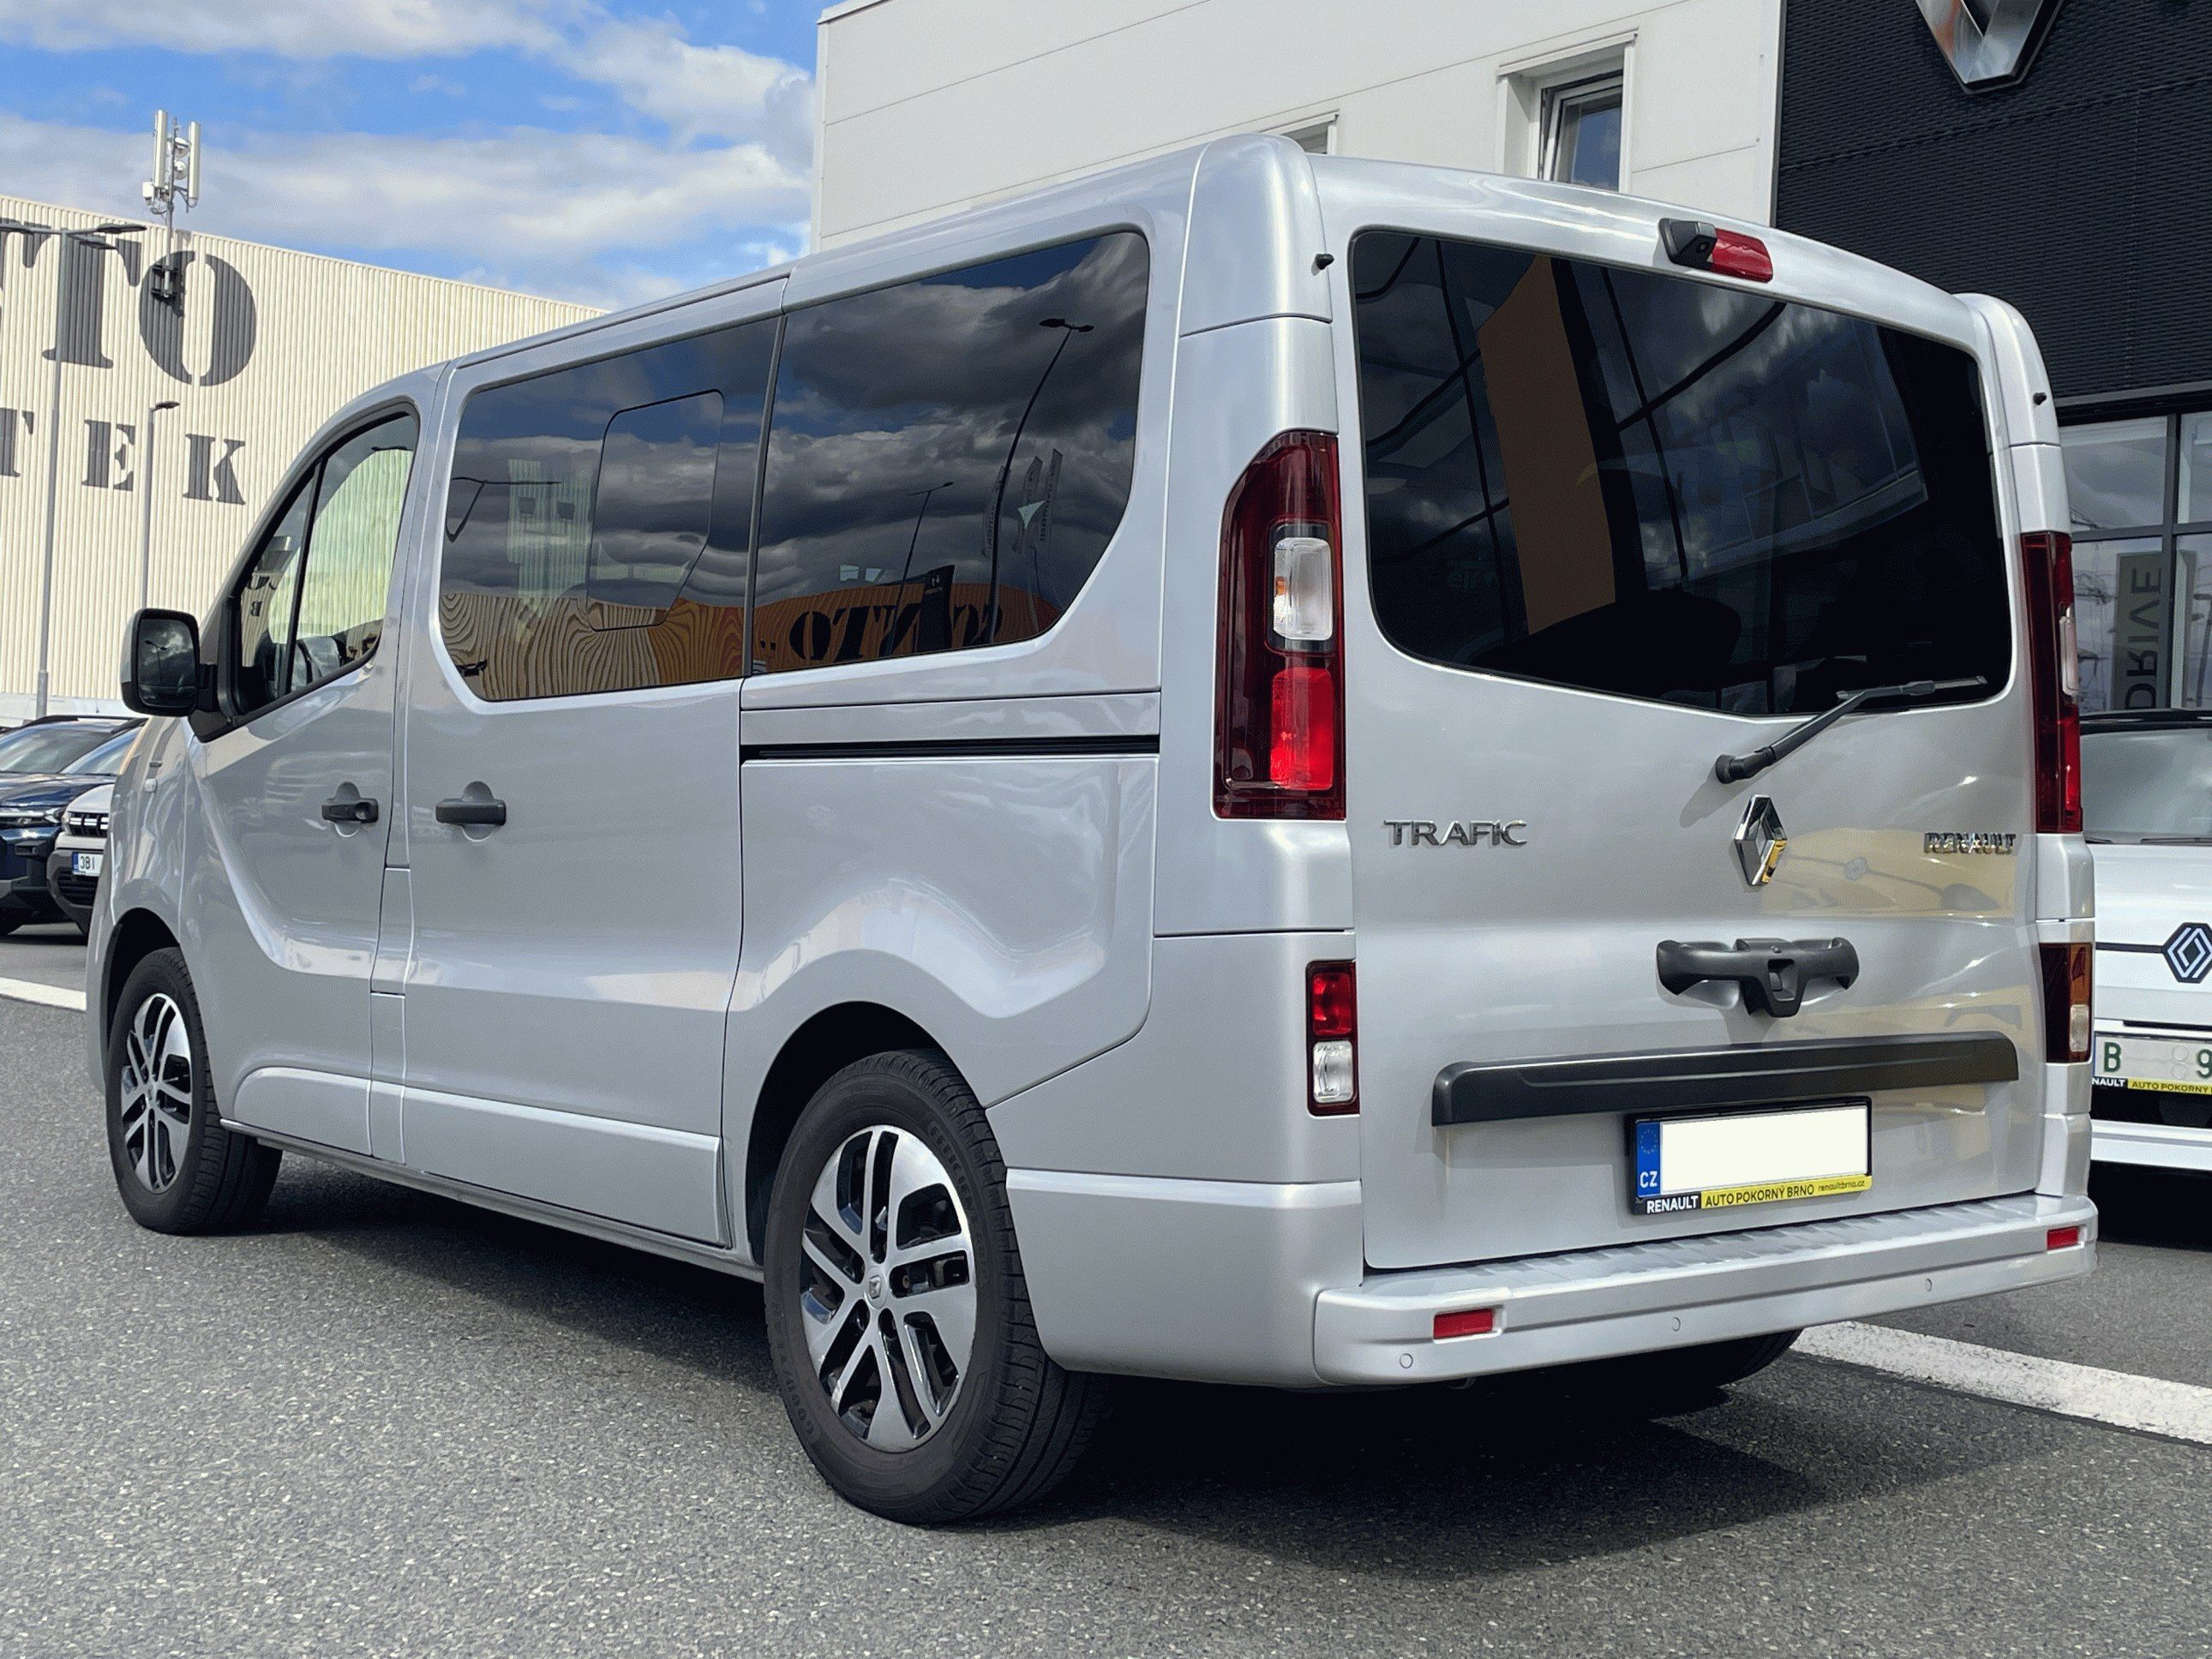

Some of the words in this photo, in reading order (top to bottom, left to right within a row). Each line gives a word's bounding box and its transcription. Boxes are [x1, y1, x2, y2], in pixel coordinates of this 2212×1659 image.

[0, 218, 257, 386] TO
[1383, 819, 1527, 847] TRAFIC
[1924, 831, 2017, 854] RENAULT
[2104, 1041, 2122, 1072] B
[2196, 1048, 2212, 1079] 9
[2131, 1081, 2159, 1090] AUTO
[1639, 1171, 1658, 1189] CZ
[1646, 1195, 1699, 1214] RENAULT
[1705, 1192, 1734, 1207] AUTO
[1736, 1186, 1784, 1204] POKORNÝ
[1787, 1183, 1814, 1198] BRNO
